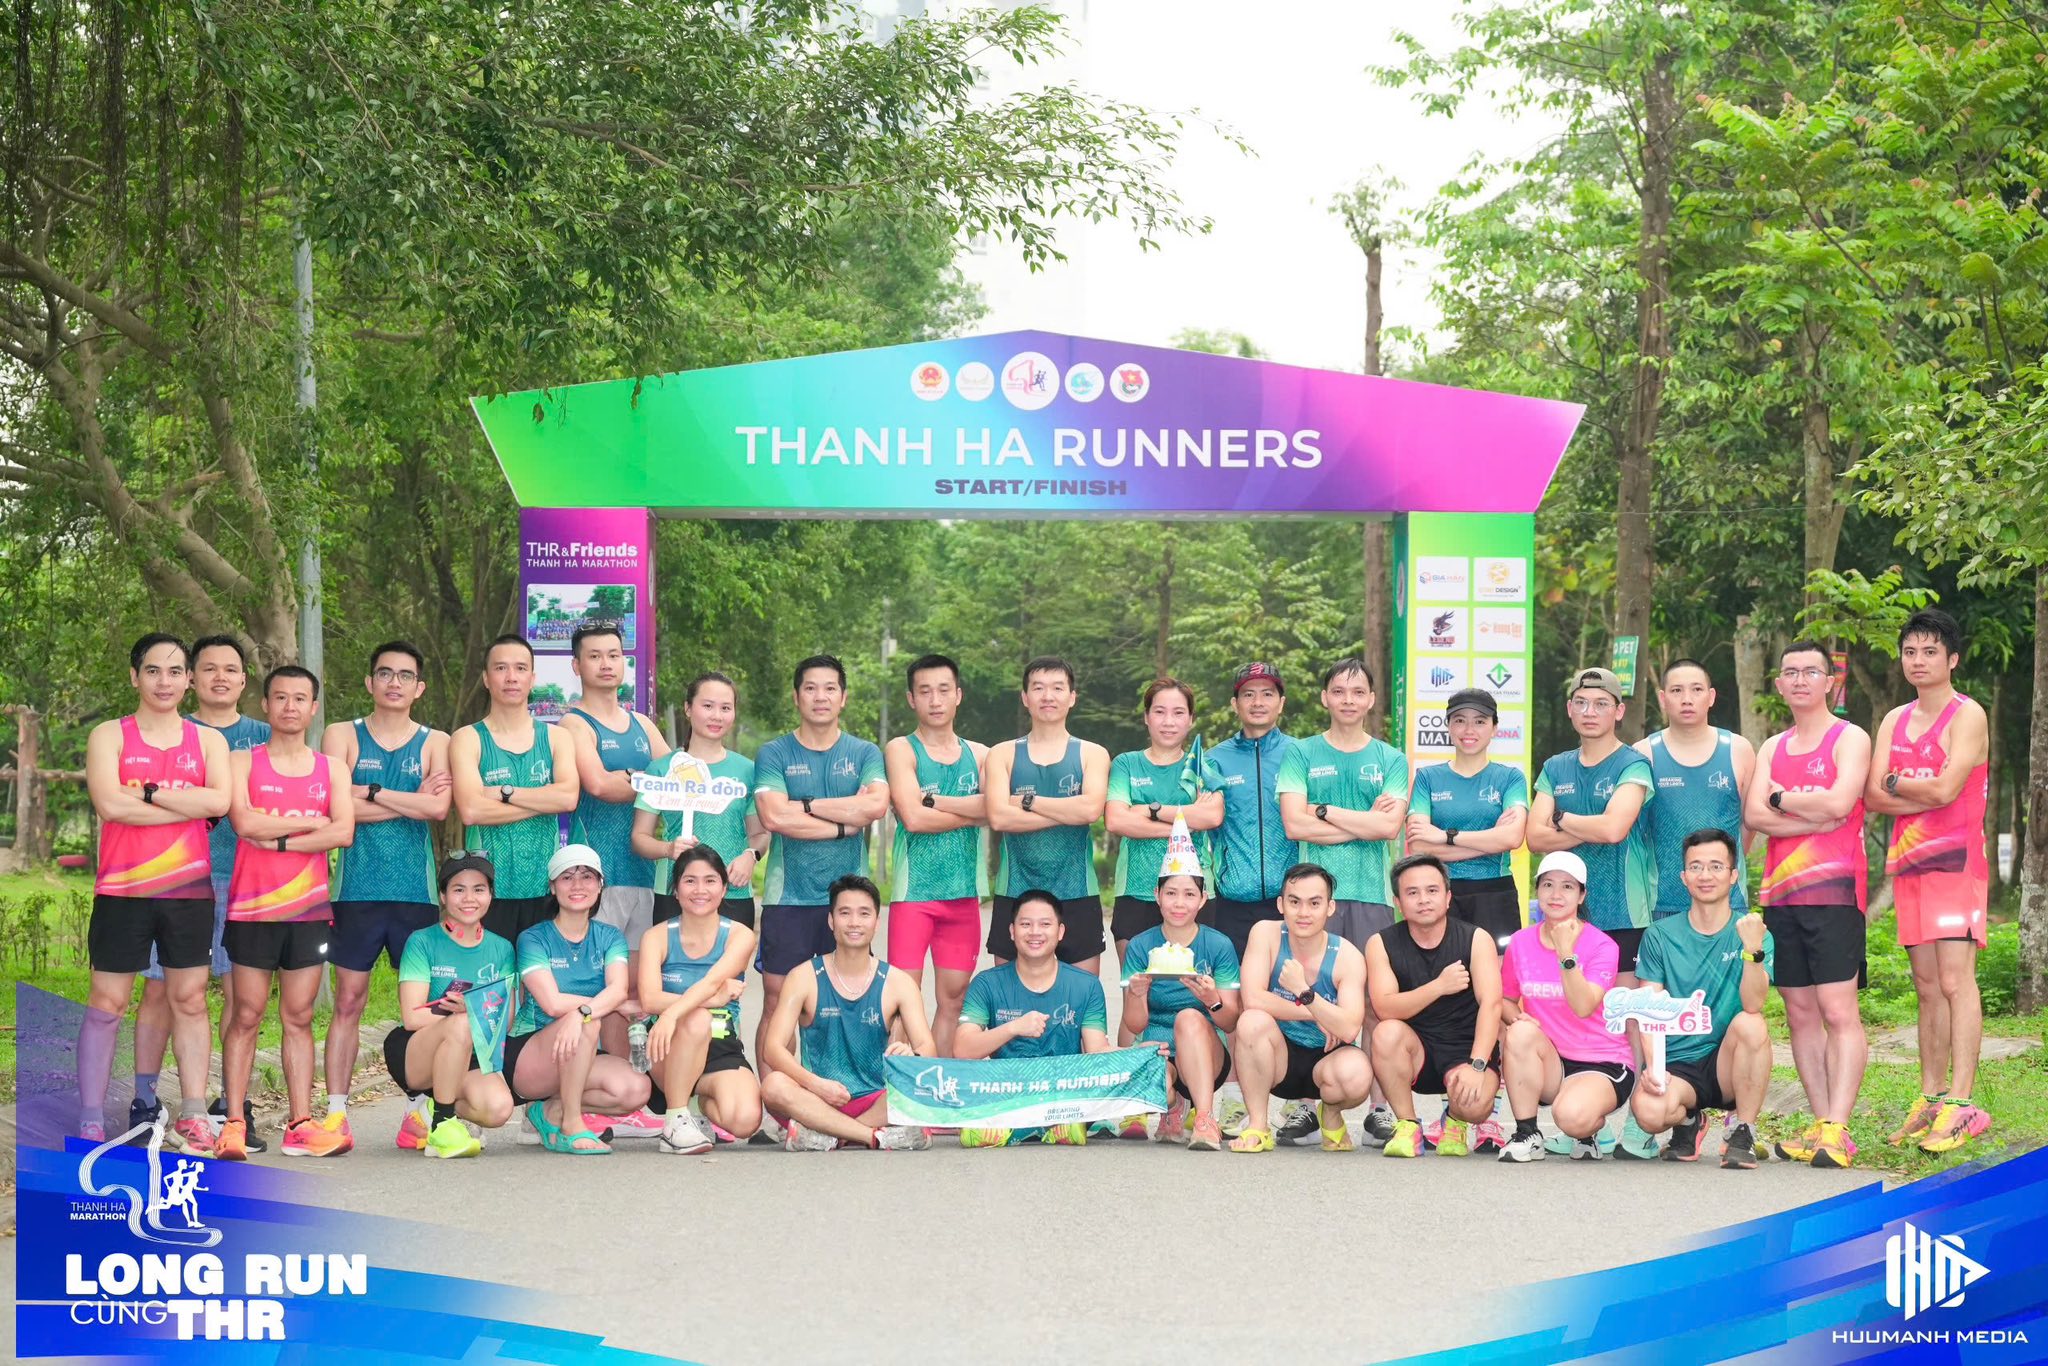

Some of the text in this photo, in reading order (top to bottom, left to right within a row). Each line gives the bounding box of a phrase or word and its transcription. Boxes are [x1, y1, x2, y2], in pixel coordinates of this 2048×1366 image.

[735, 426, 1323, 468] THANH HA RUNNERS
[935, 479, 1127, 496] START/FINISH
[526, 559, 638, 568] THANH HA MARATHON
[1420, 731, 1450, 745] MAT
[633, 777, 680, 792] Team
[685, 780, 706, 794] Ra
[1521, 982, 1564, 997] CREW
[1642, 1023, 1667, 1032] THR
[1679, 1012, 1697, 1033] 6
[1702, 1008, 1712, 1032] year
[1029, 1081, 1051, 1092] HA
